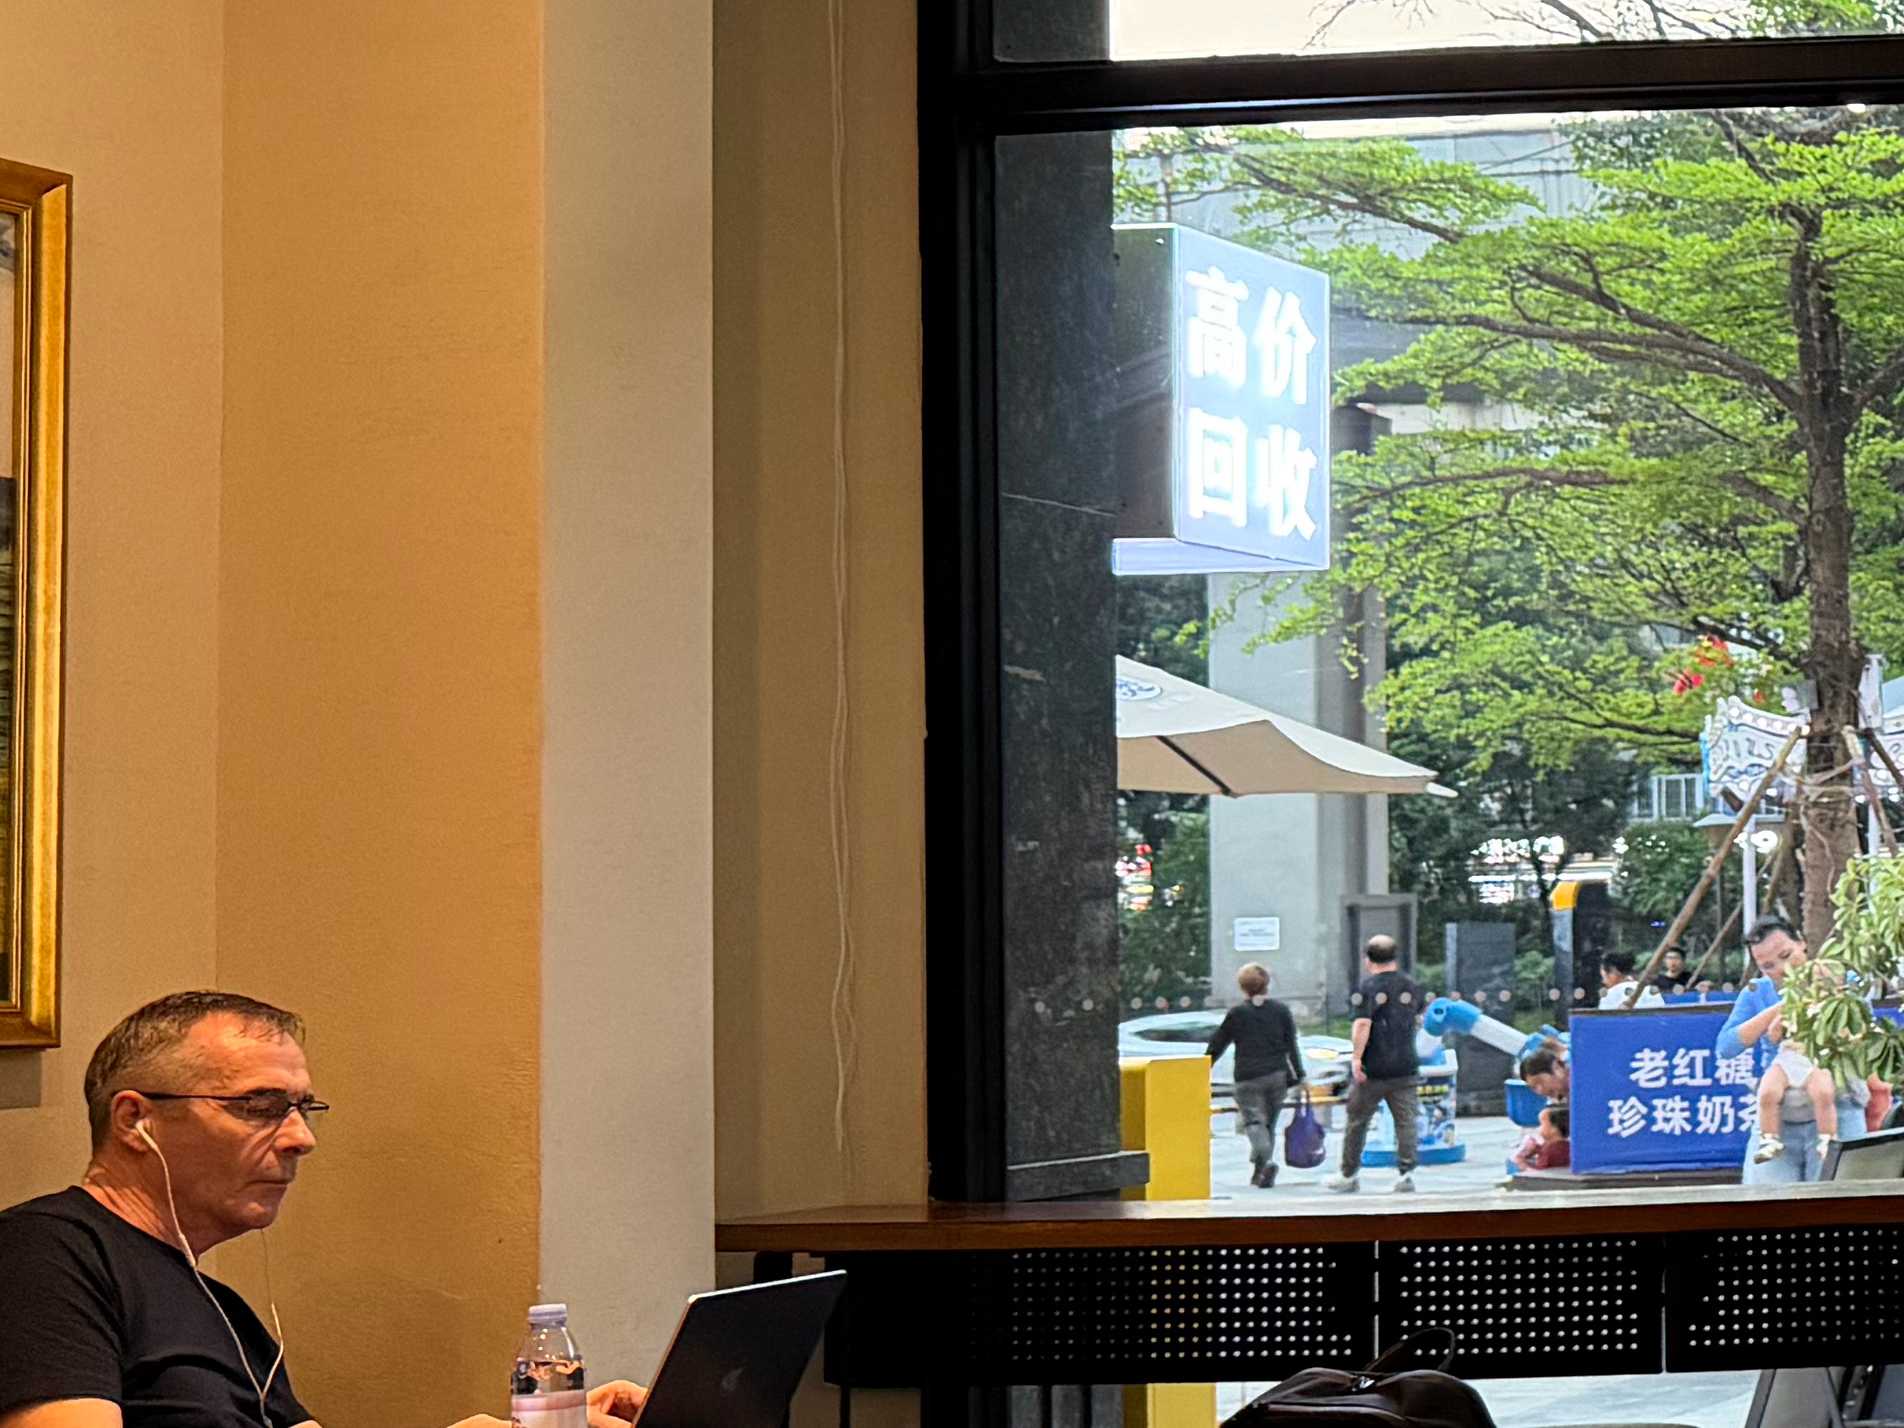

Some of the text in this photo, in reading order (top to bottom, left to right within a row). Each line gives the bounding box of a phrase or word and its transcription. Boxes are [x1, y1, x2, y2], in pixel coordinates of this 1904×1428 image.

[1185, 266, 1318, 405] 高价
[1186, 407, 1317, 540] 回收
[1629, 1048, 1758, 1089] 老红糖
